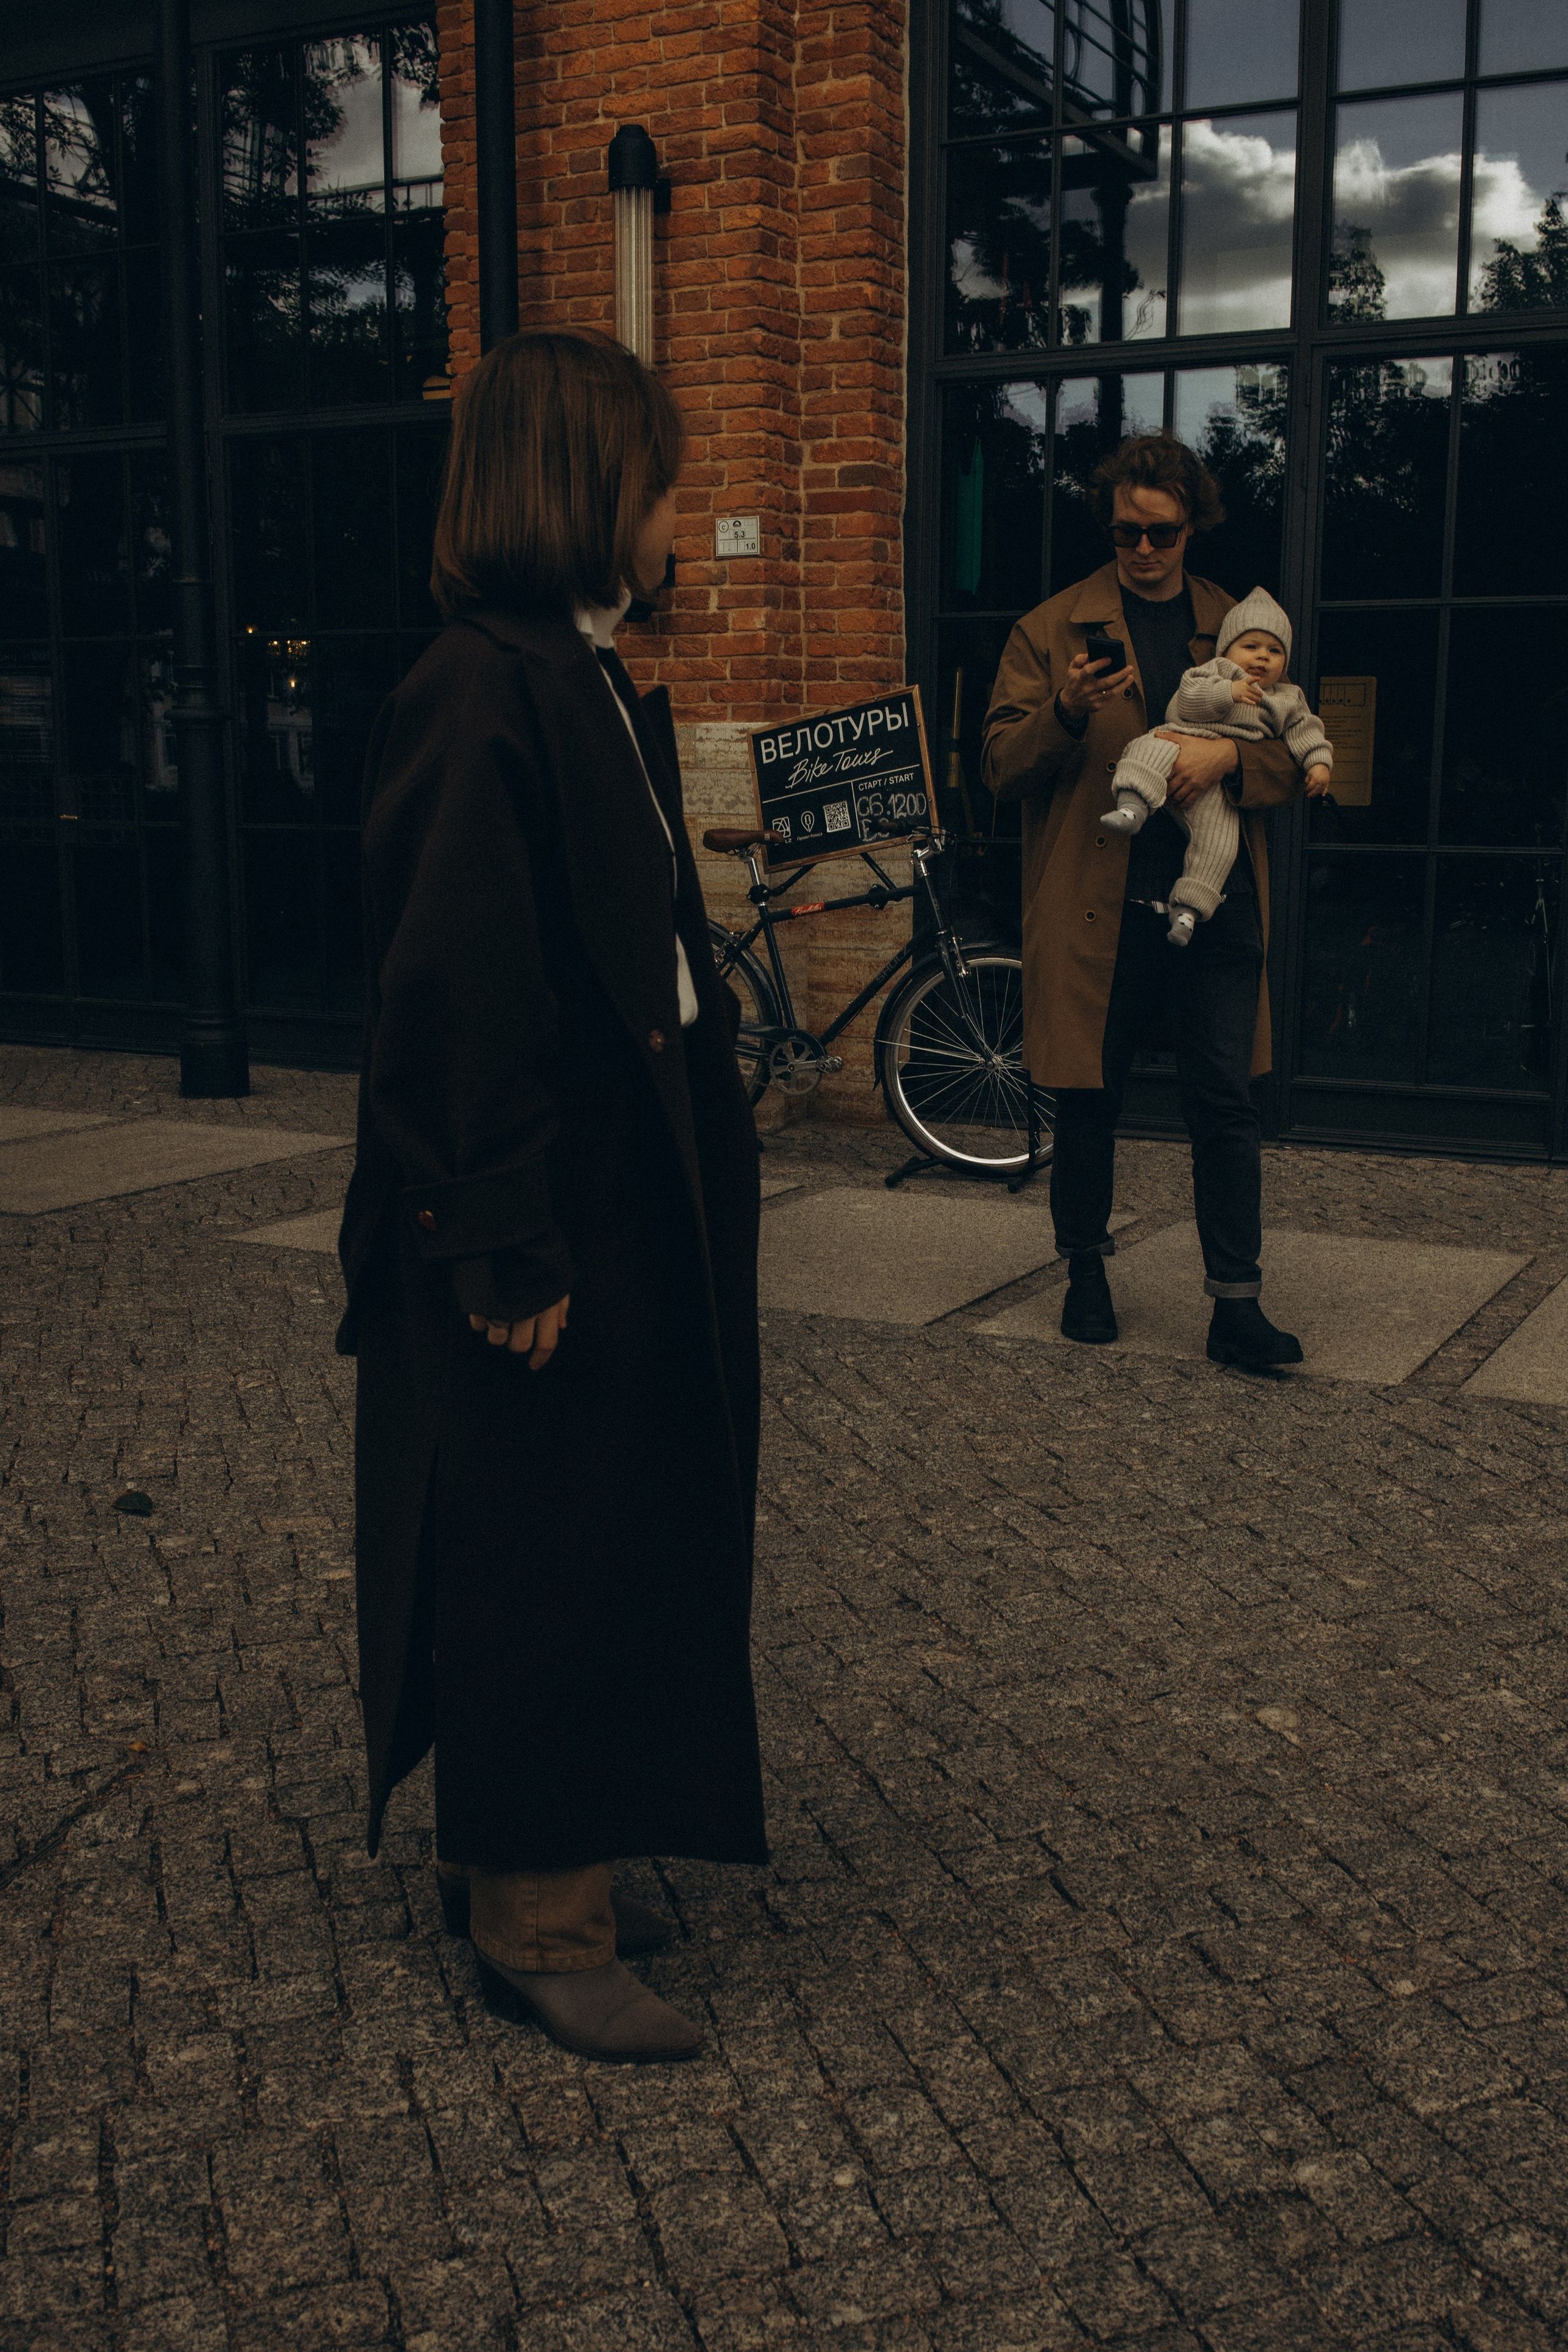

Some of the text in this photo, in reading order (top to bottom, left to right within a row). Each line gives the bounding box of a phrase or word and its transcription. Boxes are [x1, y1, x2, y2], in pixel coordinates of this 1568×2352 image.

[760, 702, 909, 764] ВЕЛОТУРЫ
[785, 747, 894, 790] Bike Tours
[858, 780, 883, 791] СТАРТ
[889, 773, 914, 785] START
